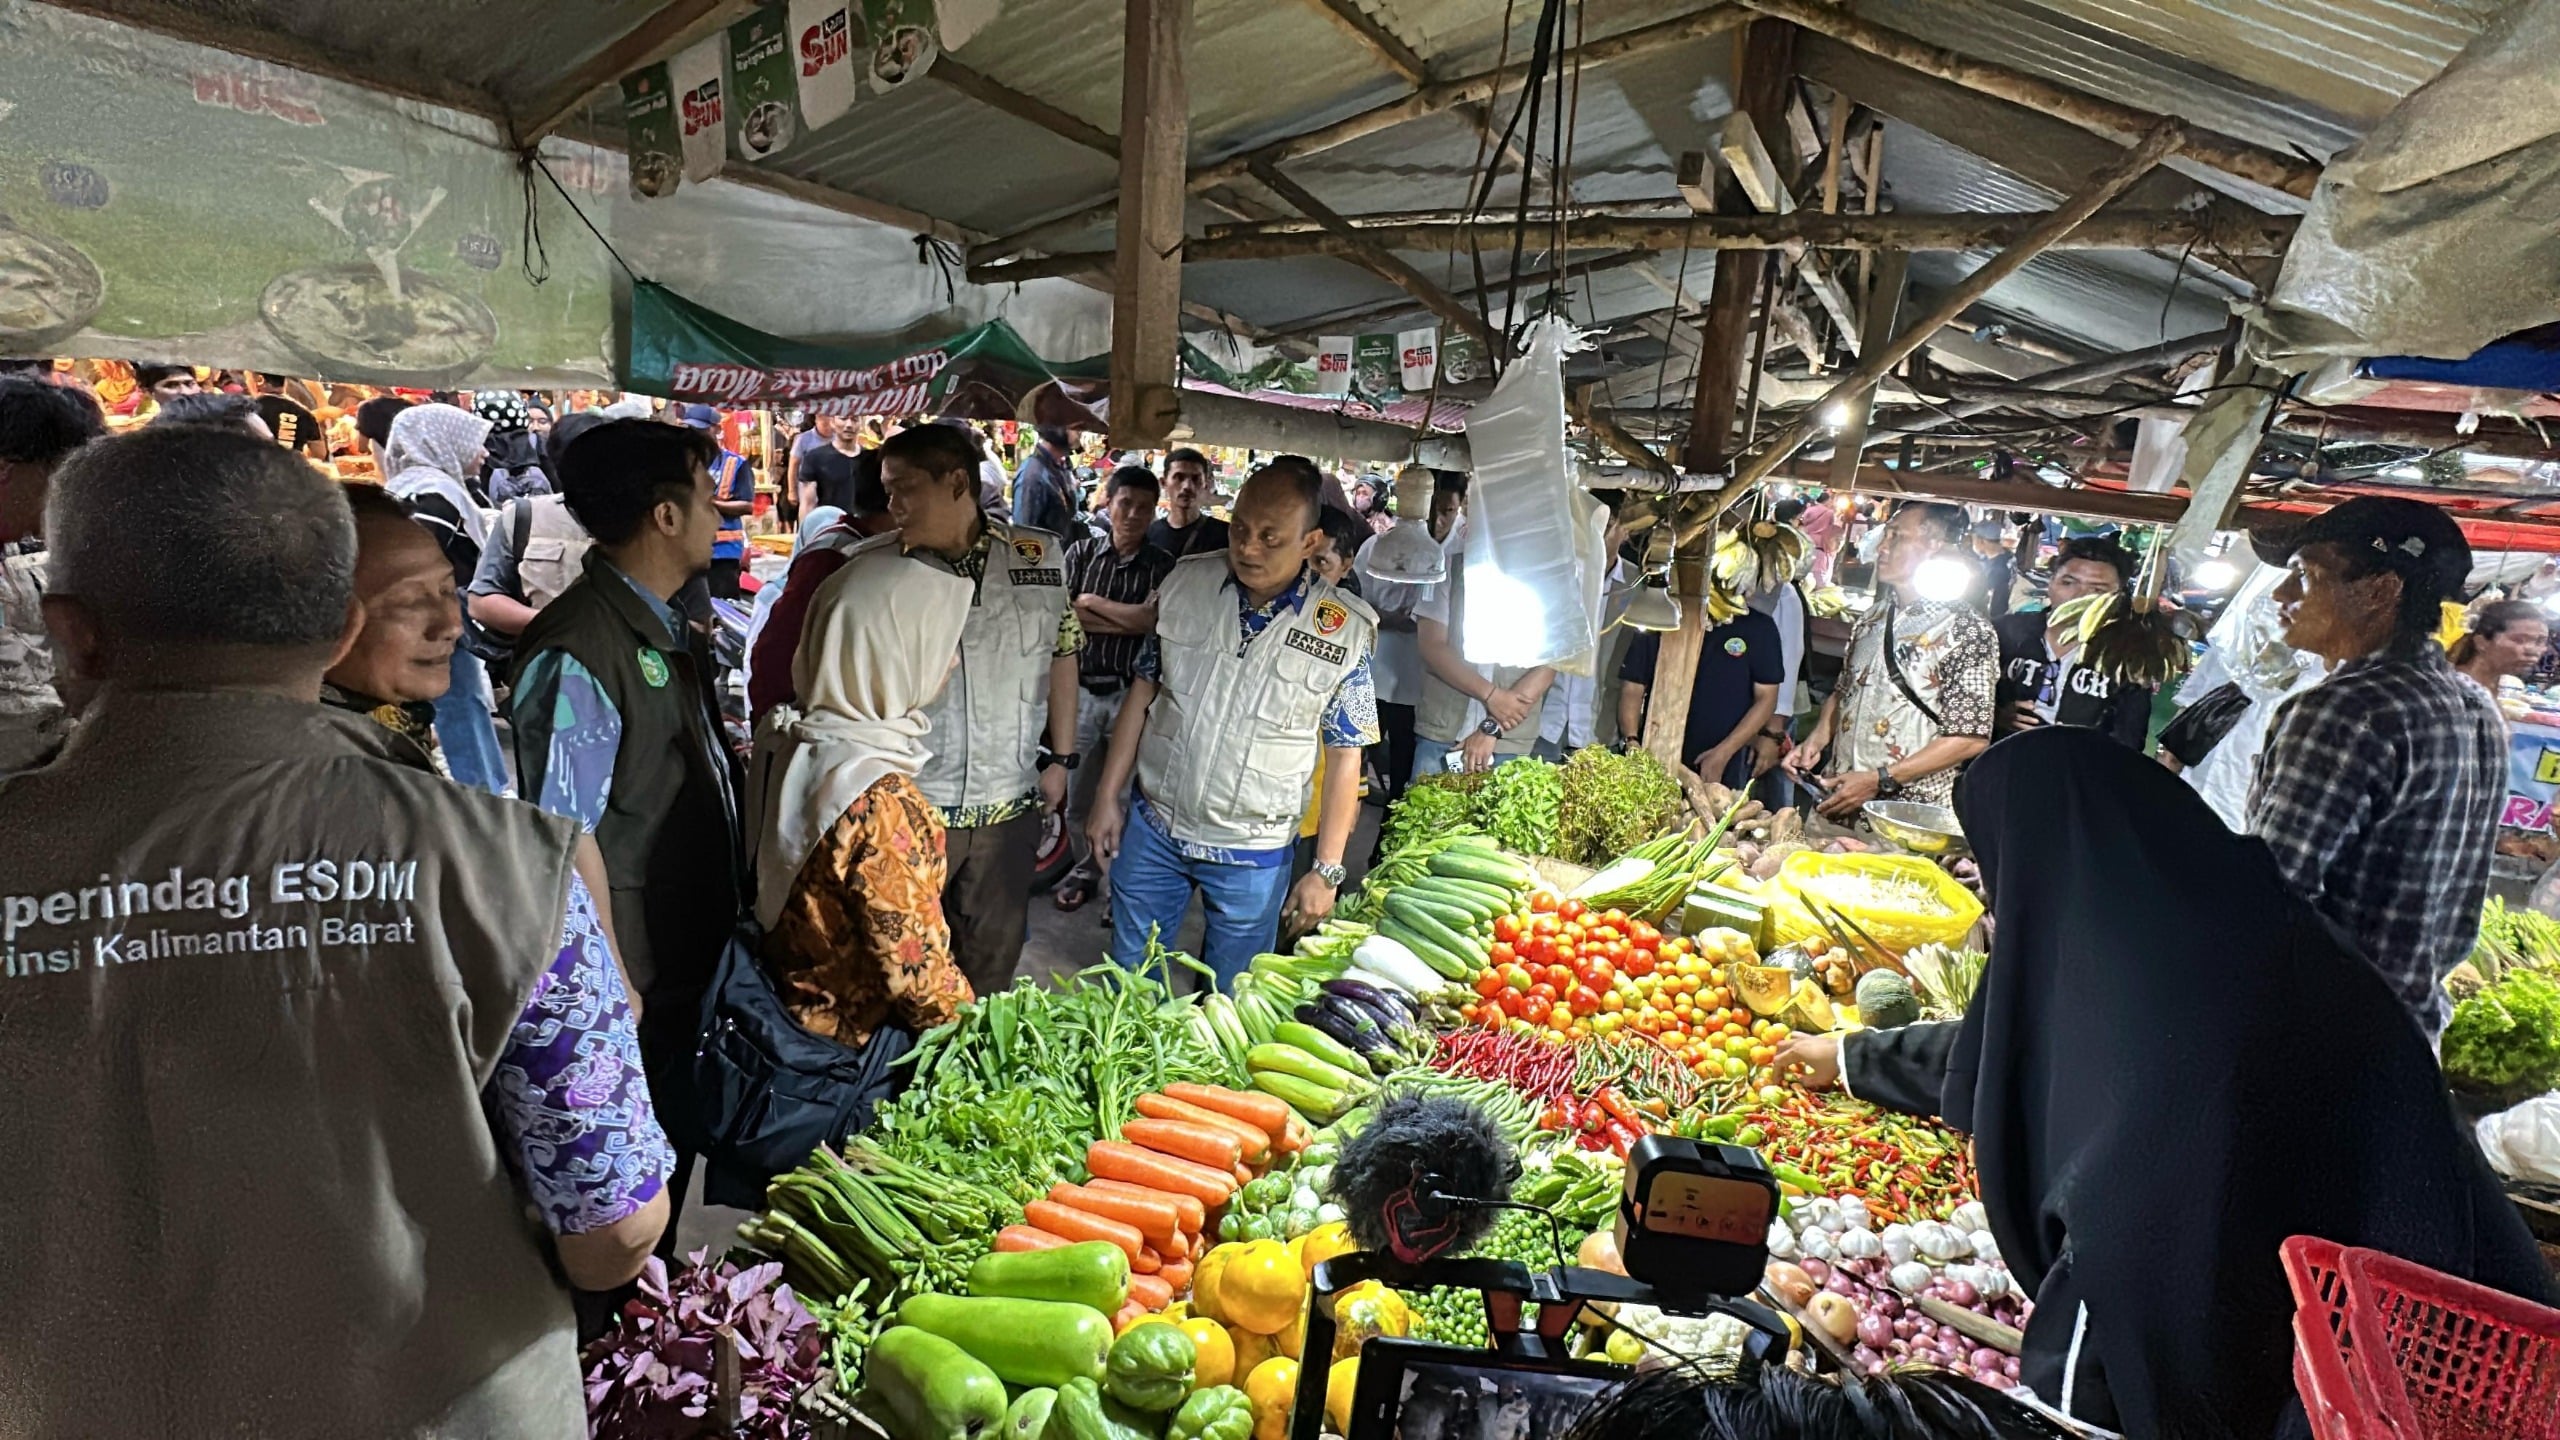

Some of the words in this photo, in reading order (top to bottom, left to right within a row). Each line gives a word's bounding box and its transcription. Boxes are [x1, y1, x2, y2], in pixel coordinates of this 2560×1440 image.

[800, 25, 848, 77] SUN
[682, 88, 722, 136] SUN
[890, 350, 948, 384] dari
[1319, 352, 1348, 373] SUN
[1404, 348, 1433, 368] SUN
[673, 365, 765, 401] Masa
[809, 366, 884, 393] Masa
[1290, 638, 1340, 662] PANGAN
[1293, 631, 1342, 655] SATGAS
[0, 867, 250, 940] perindag
[270, 860, 418, 904] ESDM
[0, 939, 80, 978] insi
[93, 921, 308, 968] Kalimantan
[320, 915, 416, 947] Barat
